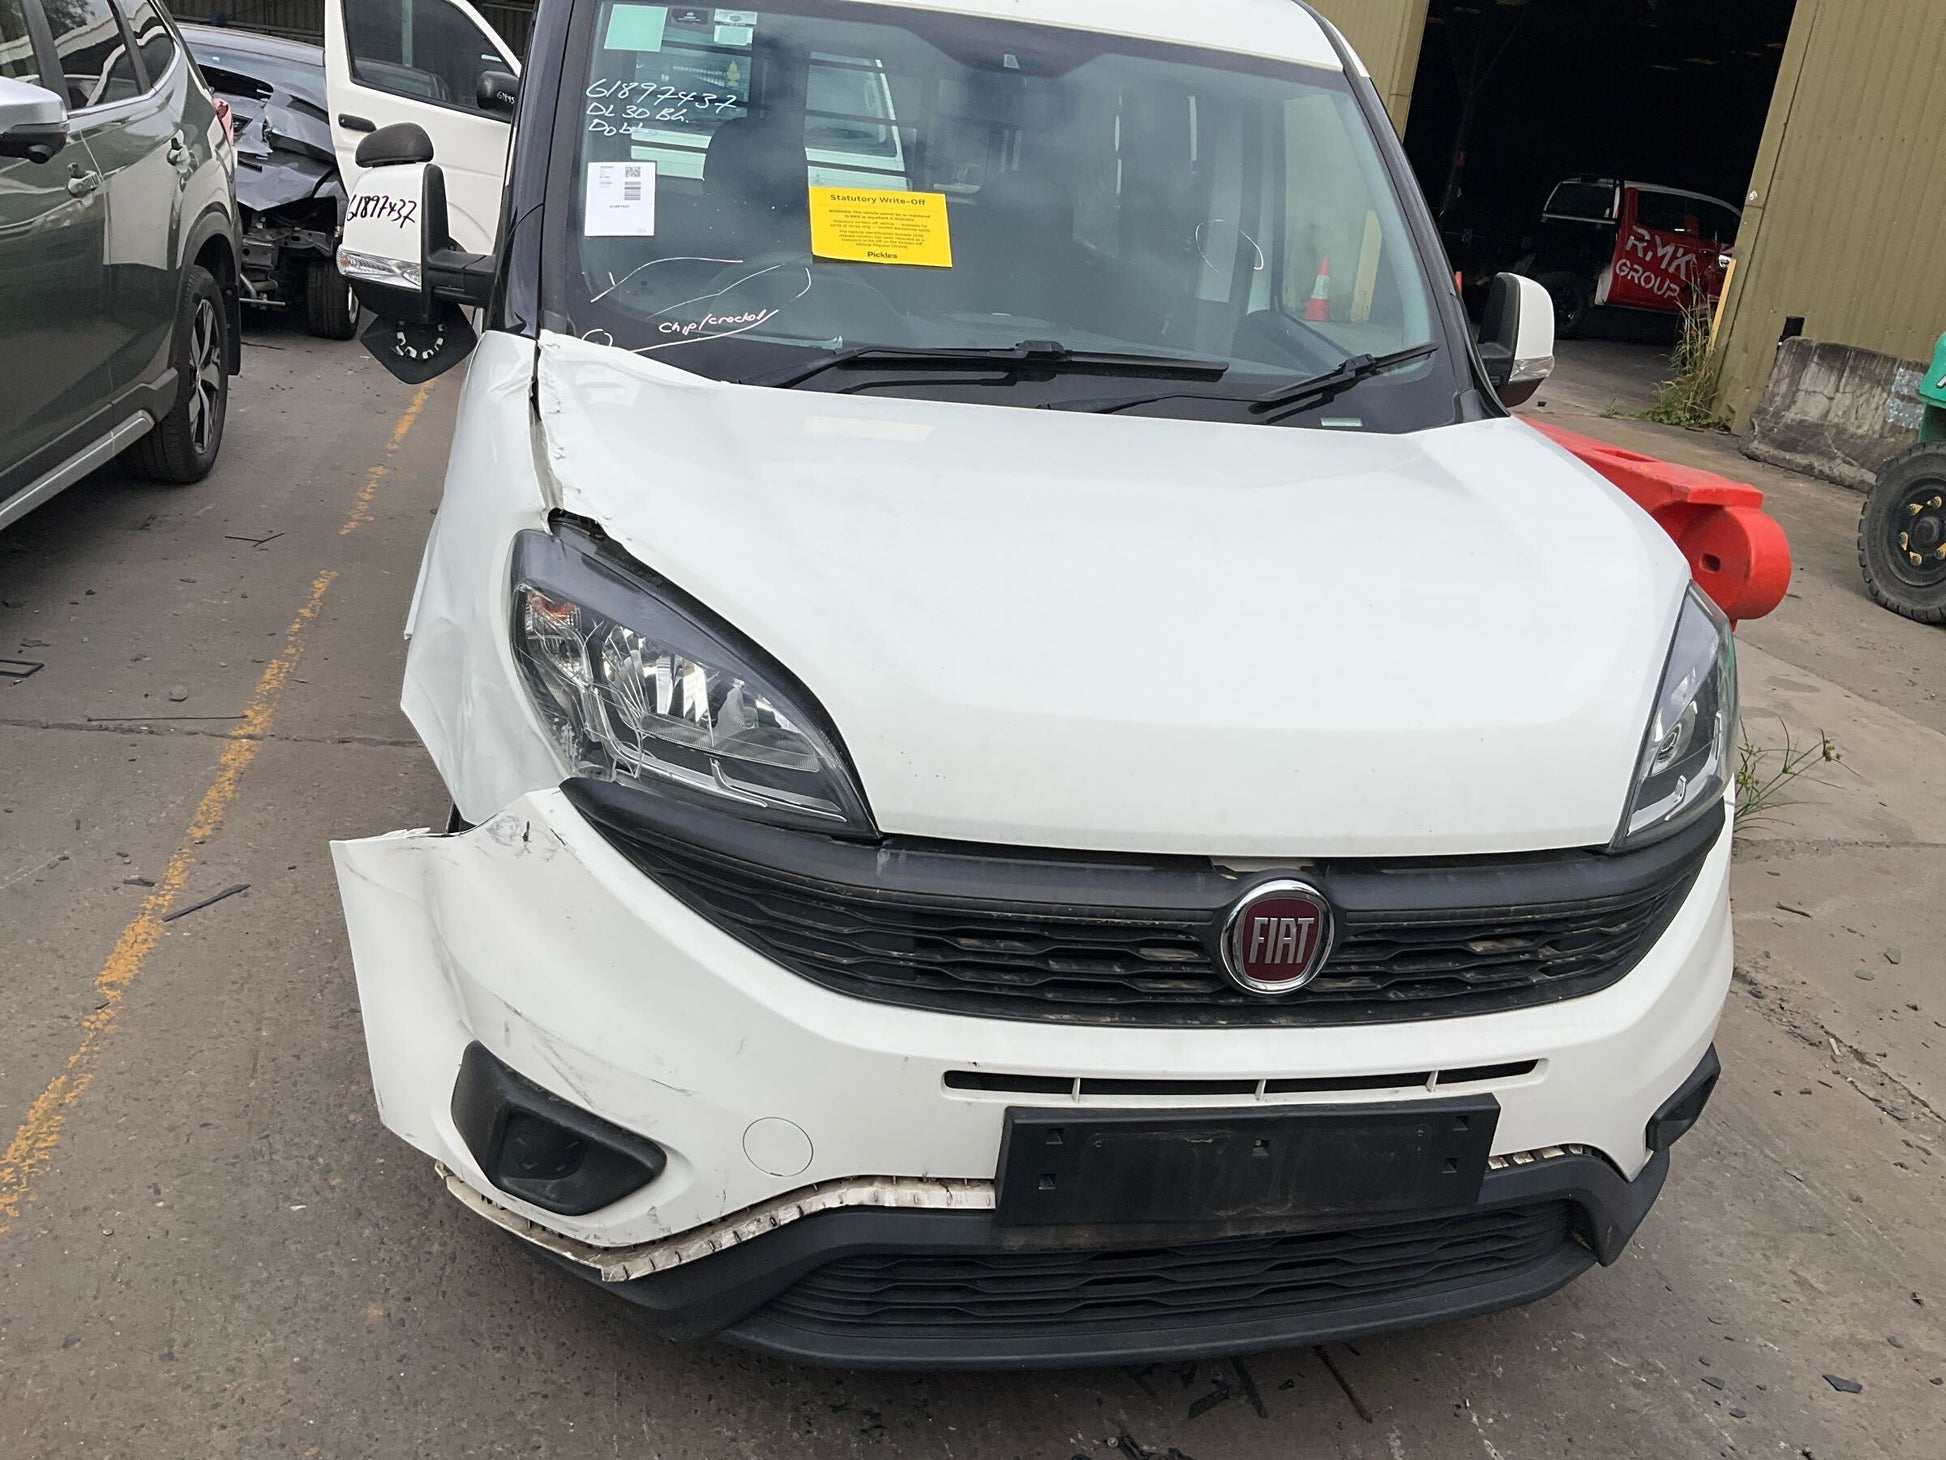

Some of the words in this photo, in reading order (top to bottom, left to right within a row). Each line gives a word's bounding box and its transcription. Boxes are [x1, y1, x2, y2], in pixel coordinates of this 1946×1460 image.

[585, 78, 737, 114] 61897437
[346, 193, 417, 229] 61897437
[830, 194, 877, 204] Statutory
[879, 196, 926, 206] Write-Off
[867, 251, 898, 259] Pickles
[1625, 225, 1696, 280] RMK
[1615, 258, 1680, 299] GROUP
[1248, 916, 1315, 964] FIAT
